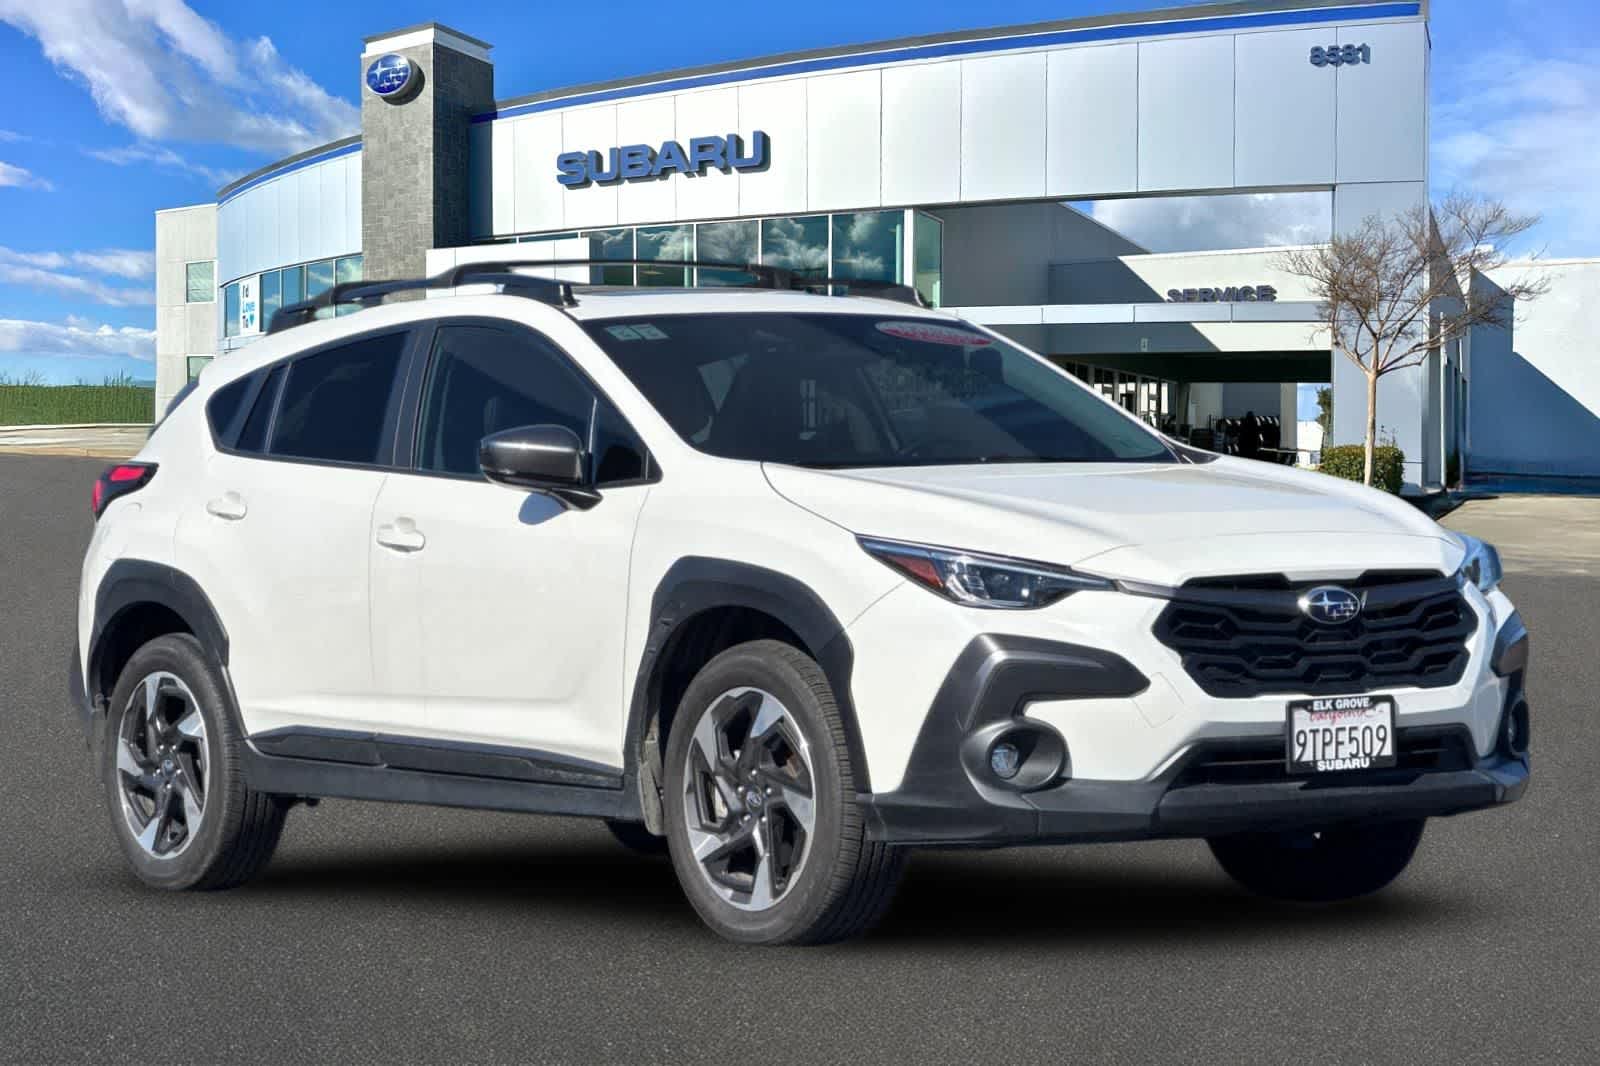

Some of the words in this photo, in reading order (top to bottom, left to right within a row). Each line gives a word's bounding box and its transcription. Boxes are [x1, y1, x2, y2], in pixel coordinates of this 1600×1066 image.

[557, 130, 770, 189] SUBARU
[1167, 285, 1277, 302] SERVICE
[1313, 700, 1333, 711] ELK
[1335, 698, 1370, 709] GROVE
[1296, 725, 1387, 761] 9TPF509
[1317, 757, 1370, 771] SUBARU
